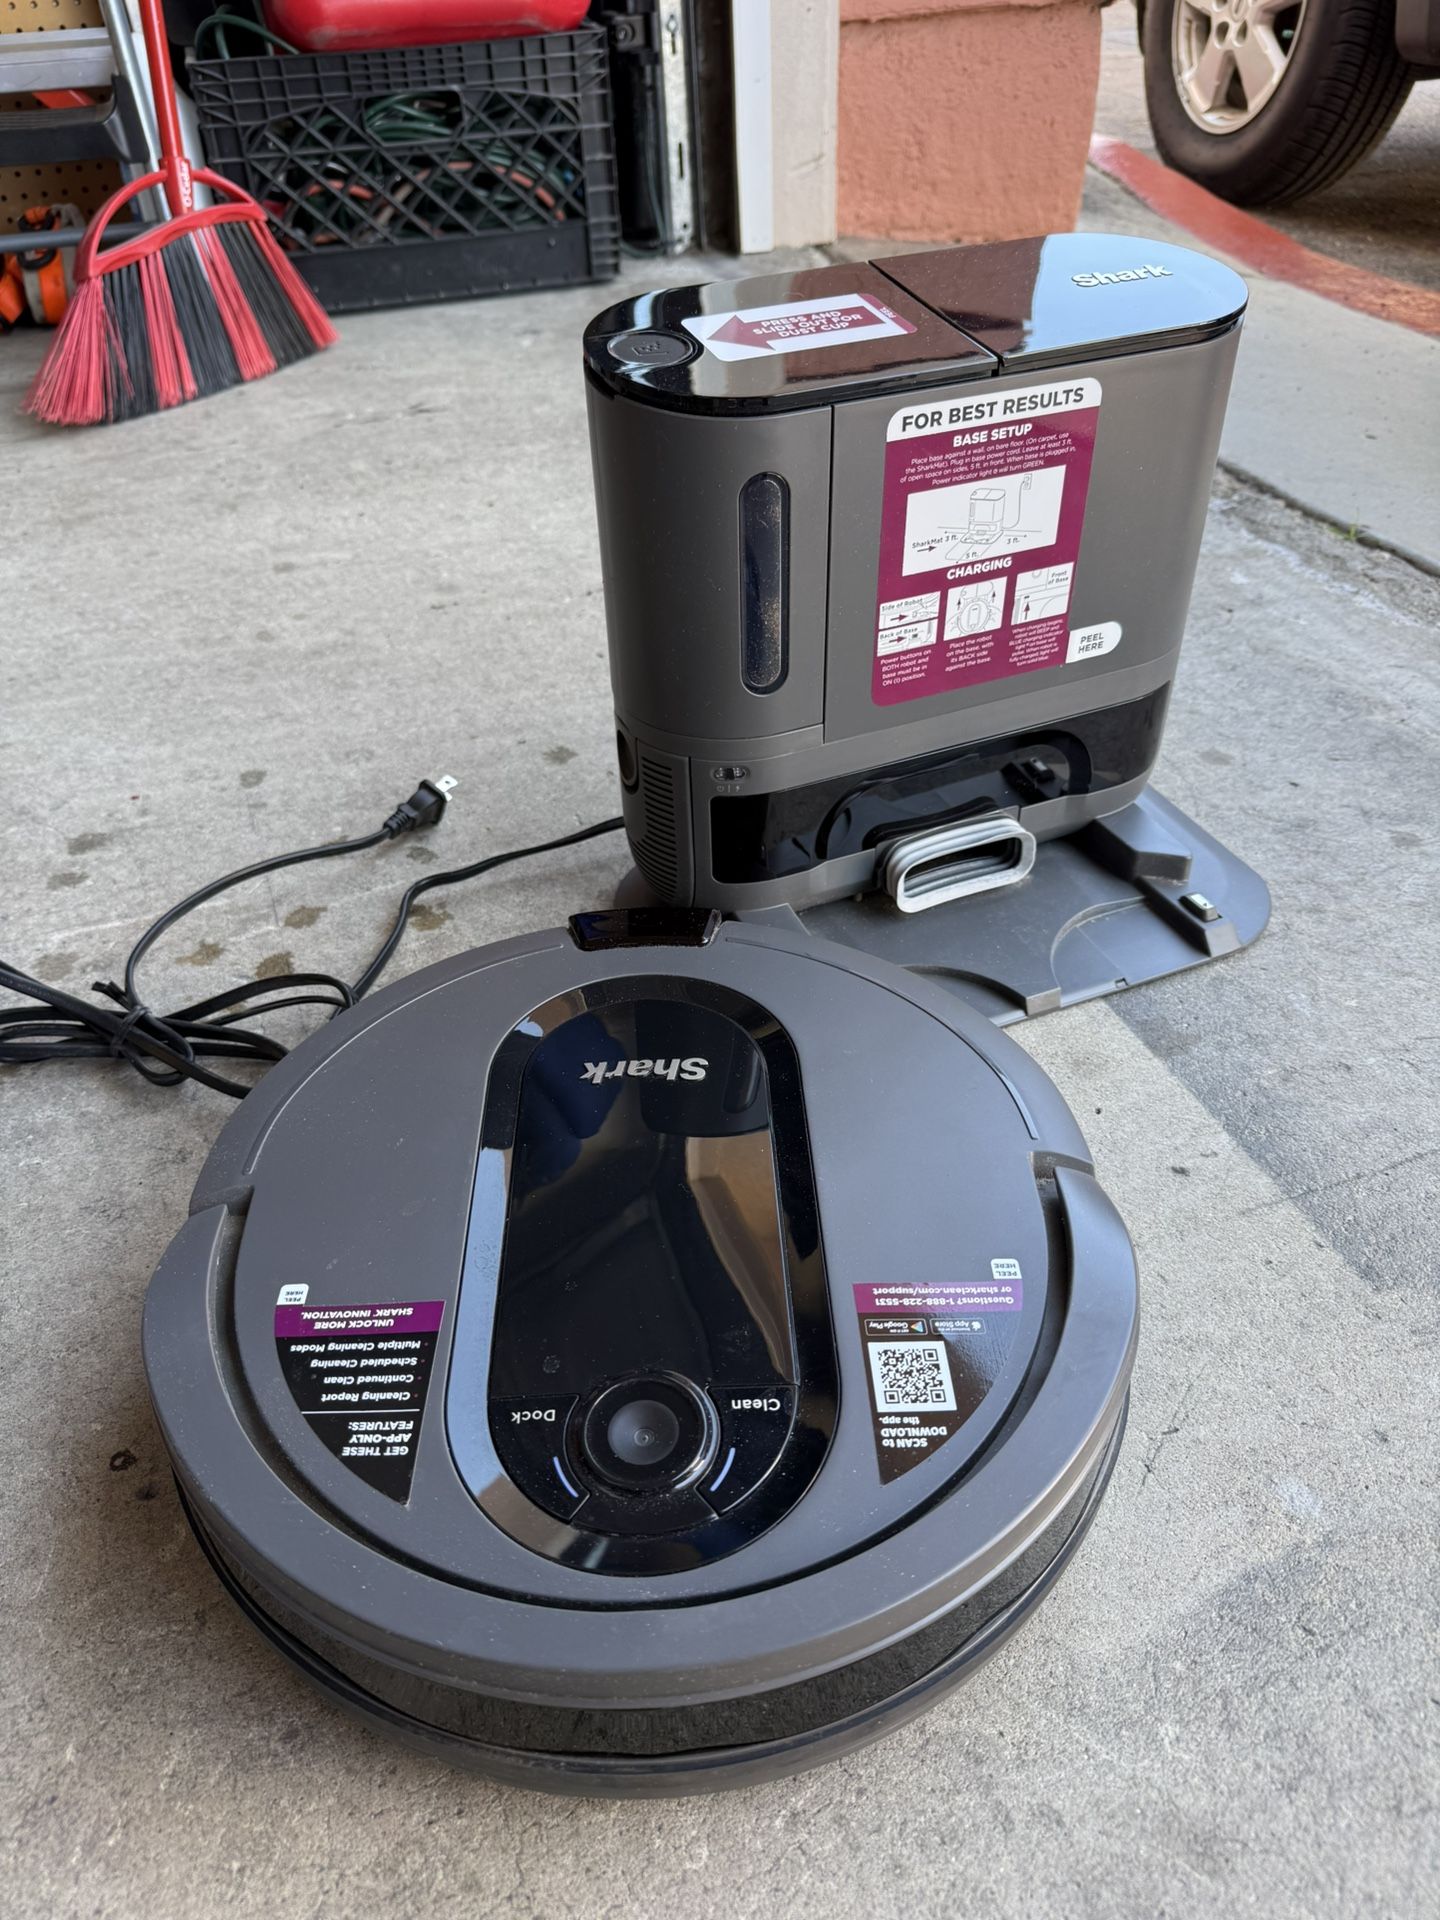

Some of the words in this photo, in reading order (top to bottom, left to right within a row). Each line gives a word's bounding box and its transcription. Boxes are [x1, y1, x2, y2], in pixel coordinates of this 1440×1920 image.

[1071, 264, 1173, 288] Shark
[761, 315, 809, 328] PRESS
[811, 310, 842, 321] AND
[752, 324, 796, 336] SLIDE
[798, 318, 828, 330] OUT
[832, 313, 863, 324] FOR
[778, 326, 819, 338] DUST
[820, 321, 850, 333] CUP
[901, 410, 943, 432] FOR
[948, 401, 998, 424] BEST
[1003, 387, 1084, 415] RESULTS
[952, 430, 988, 447] BASE
[991, 423, 1033, 441] SETUP
[929, 454, 943, 462] base
[944, 450, 966, 459] against
[1025, 437, 1037, 445] (On
[905, 466, 916, 475] the
[949, 458, 964, 466] Plug
[971, 454, 986, 462] base
[986, 451, 1005, 460] power
[1022, 445, 1039, 453] Leave
[1047, 441, 1061, 449] least
[900, 475, 907, 484] of
[924, 470, 942, 479] space
[1006, 455, 1024, 463] When
[1024, 452, 1040, 460] base
[1045, 447, 1069, 457] plugged
[932, 477, 951, 486] Power
[952, 472, 978, 481] indicator
[979, 469, 992, 478] light
[912, 537, 943, 549] SharkMat
[946, 556, 1012, 580] CHARGING
[1055, 576, 1069, 584] Base
[881, 604, 895, 612] Side
[880, 632, 894, 640] Back
[904, 627, 918, 635] Base
[1080, 632, 1104, 644] PEEL
[1078, 641, 1104, 654] HERE
[880, 657, 899, 665] Power
[900, 651, 922, 661] buttons
[958, 653, 976, 661] BACK
[882, 663, 899, 672] BOTH
[900, 659, 917, 667] robot
[917, 656, 929, 664] and
[882, 672, 896, 680] base
[897, 668, 912, 676] must
[882, 679, 893, 687] ON
[579, 1057, 709, 1084] Shark
[872, 1286, 999, 1296] sharkclean.com/support
[875, 1297, 955, 1306] 1-888-228-5531
[956, 1296, 1014, 1305] Questions?
[301, 1310, 372, 1320] INNOVATION.
[314, 1320, 346, 1329] MORE
[349, 1319, 394, 1328] UNLOCK
[883, 1321, 908, 1330] Google
[954, 1321, 970, 1329] App
[290, 1344, 325, 1352] Modes
[328, 1341, 375, 1351] Cleaning
[378, 1340, 421, 1349] Multiple
[310, 1358, 358, 1368] Cleaning
[361, 1357, 418, 1366] Scheduled
[324, 1376, 354, 1384] Clean
[357, 1374, 414, 1384] Continued
[321, 1392, 359, 1402] Report
[362, 1391, 411, 1401] Cleaning
[731, 1398, 781, 1412] Clean
[511, 1409, 556, 1424] Dock
[879, 1416, 904, 1425] app.
[904, 1416, 920, 1424] the
[348, 1421, 414, 1430] FEATURES:
[880, 1426, 948, 1437] DOWNLOAD
[349, 1433, 412, 1443] APP-ONLY
[882, 1439, 894, 1447] to
[896, 1438, 928, 1448] SCAN
[342, 1447, 381, 1456] THESE
[383, 1447, 409, 1456] GET
